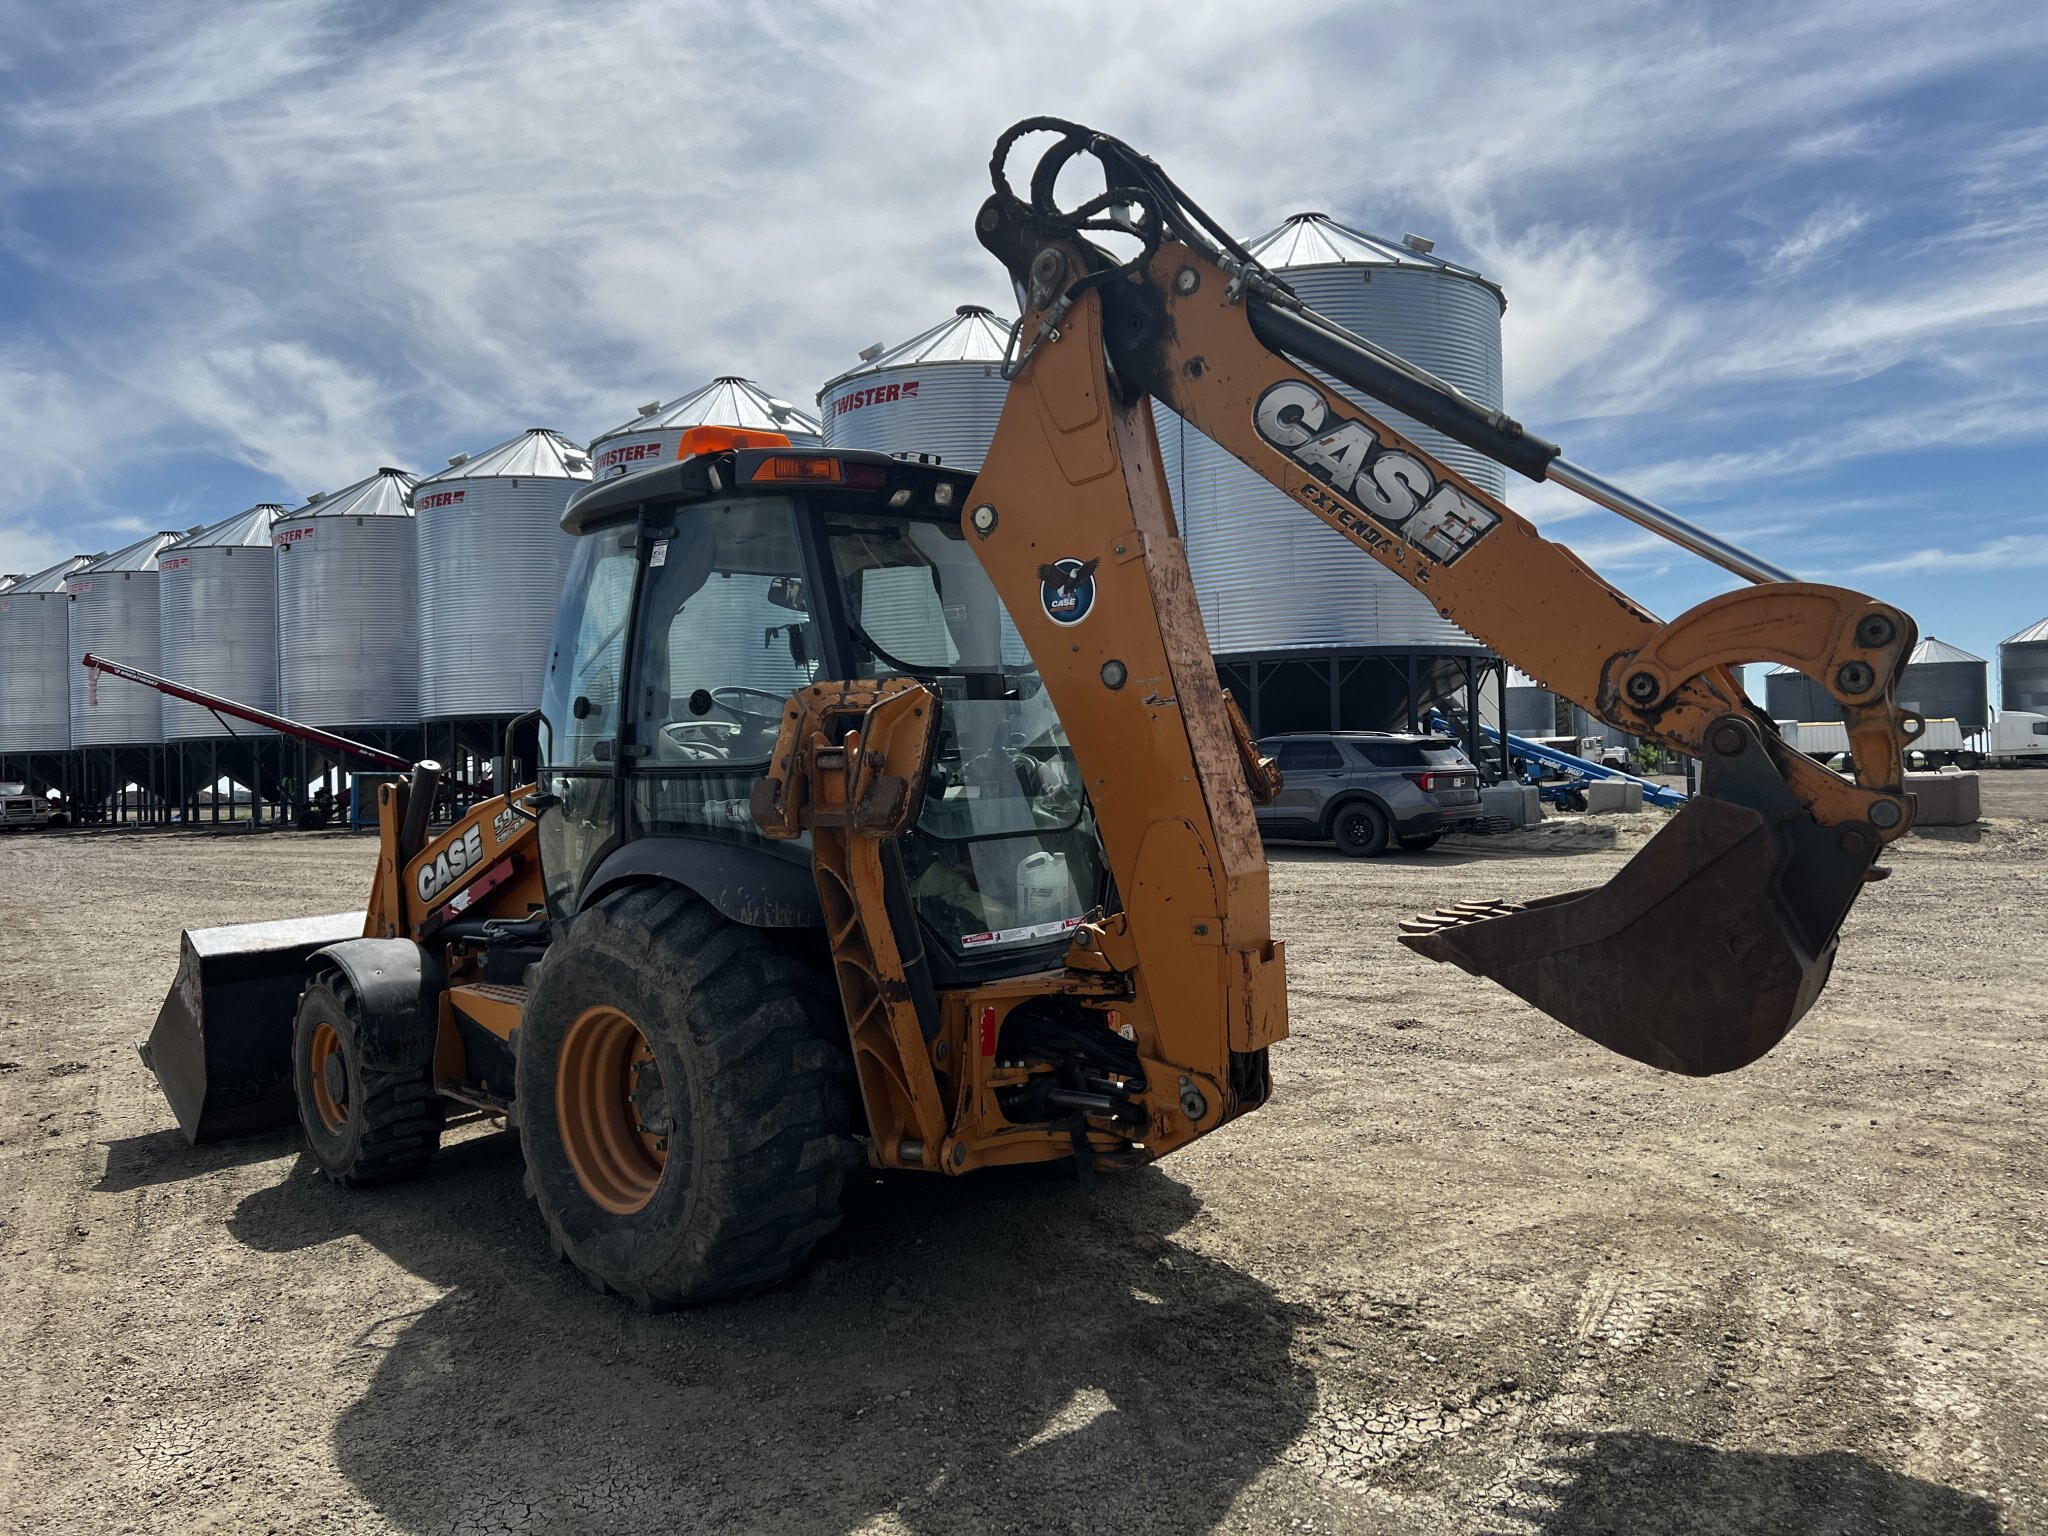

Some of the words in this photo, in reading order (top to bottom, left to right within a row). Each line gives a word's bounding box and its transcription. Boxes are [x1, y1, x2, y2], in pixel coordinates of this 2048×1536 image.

[832, 384, 900, 418] TWISTER
[1256, 384, 1497, 561] CASE
[1051, 598, 1076, 607] CASE
[418, 824, 483, 901] CASE
